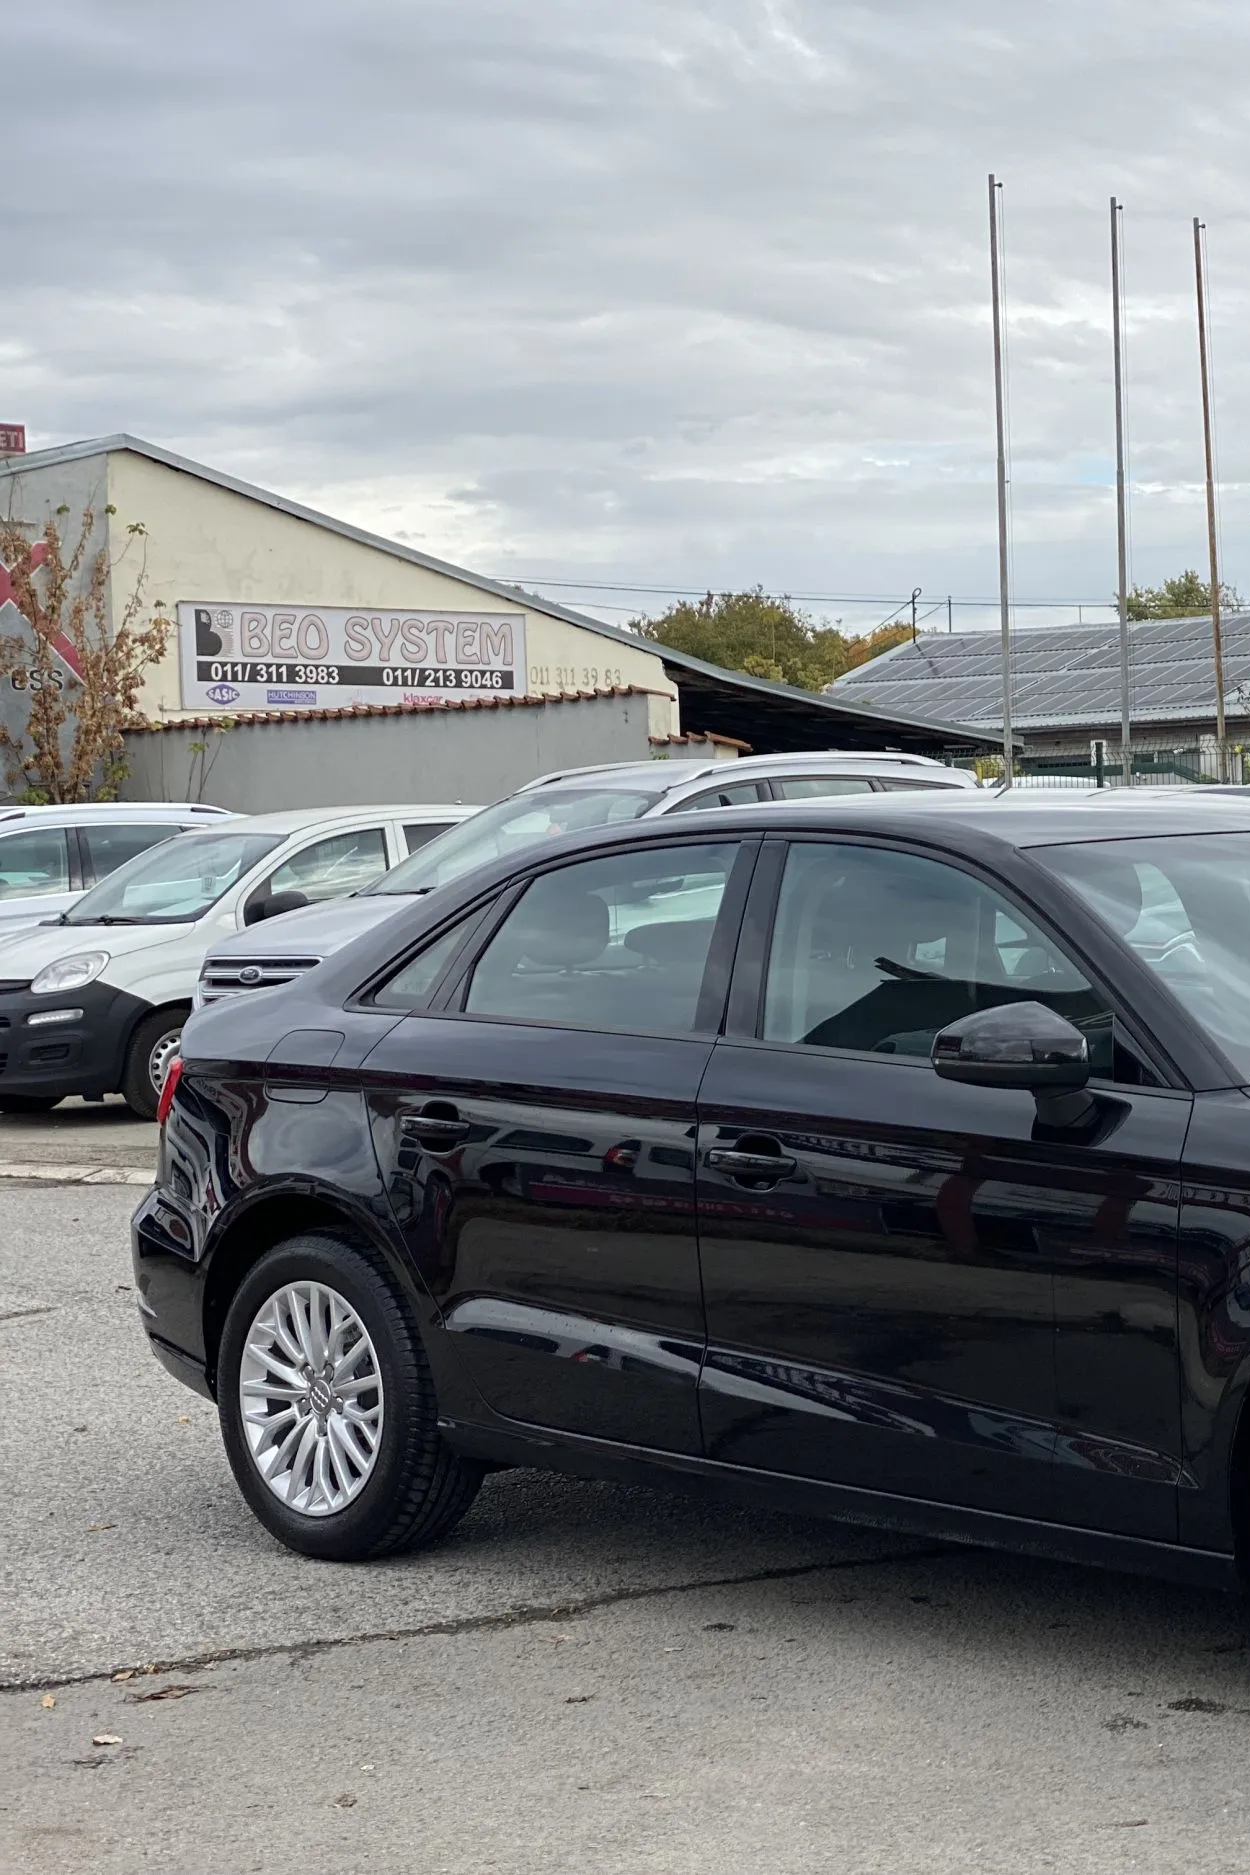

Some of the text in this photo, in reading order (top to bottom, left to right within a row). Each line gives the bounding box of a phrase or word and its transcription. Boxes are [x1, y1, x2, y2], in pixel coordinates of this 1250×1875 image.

[240, 611, 514, 666] BEO SYSTEM
[211, 662, 340, 684] 011/ 311 3983
[382, 668, 502, 688] 011/ 213 9046
[530, 666, 621, 687] 011 311 39 83
[208, 688, 238, 700] SASIC
